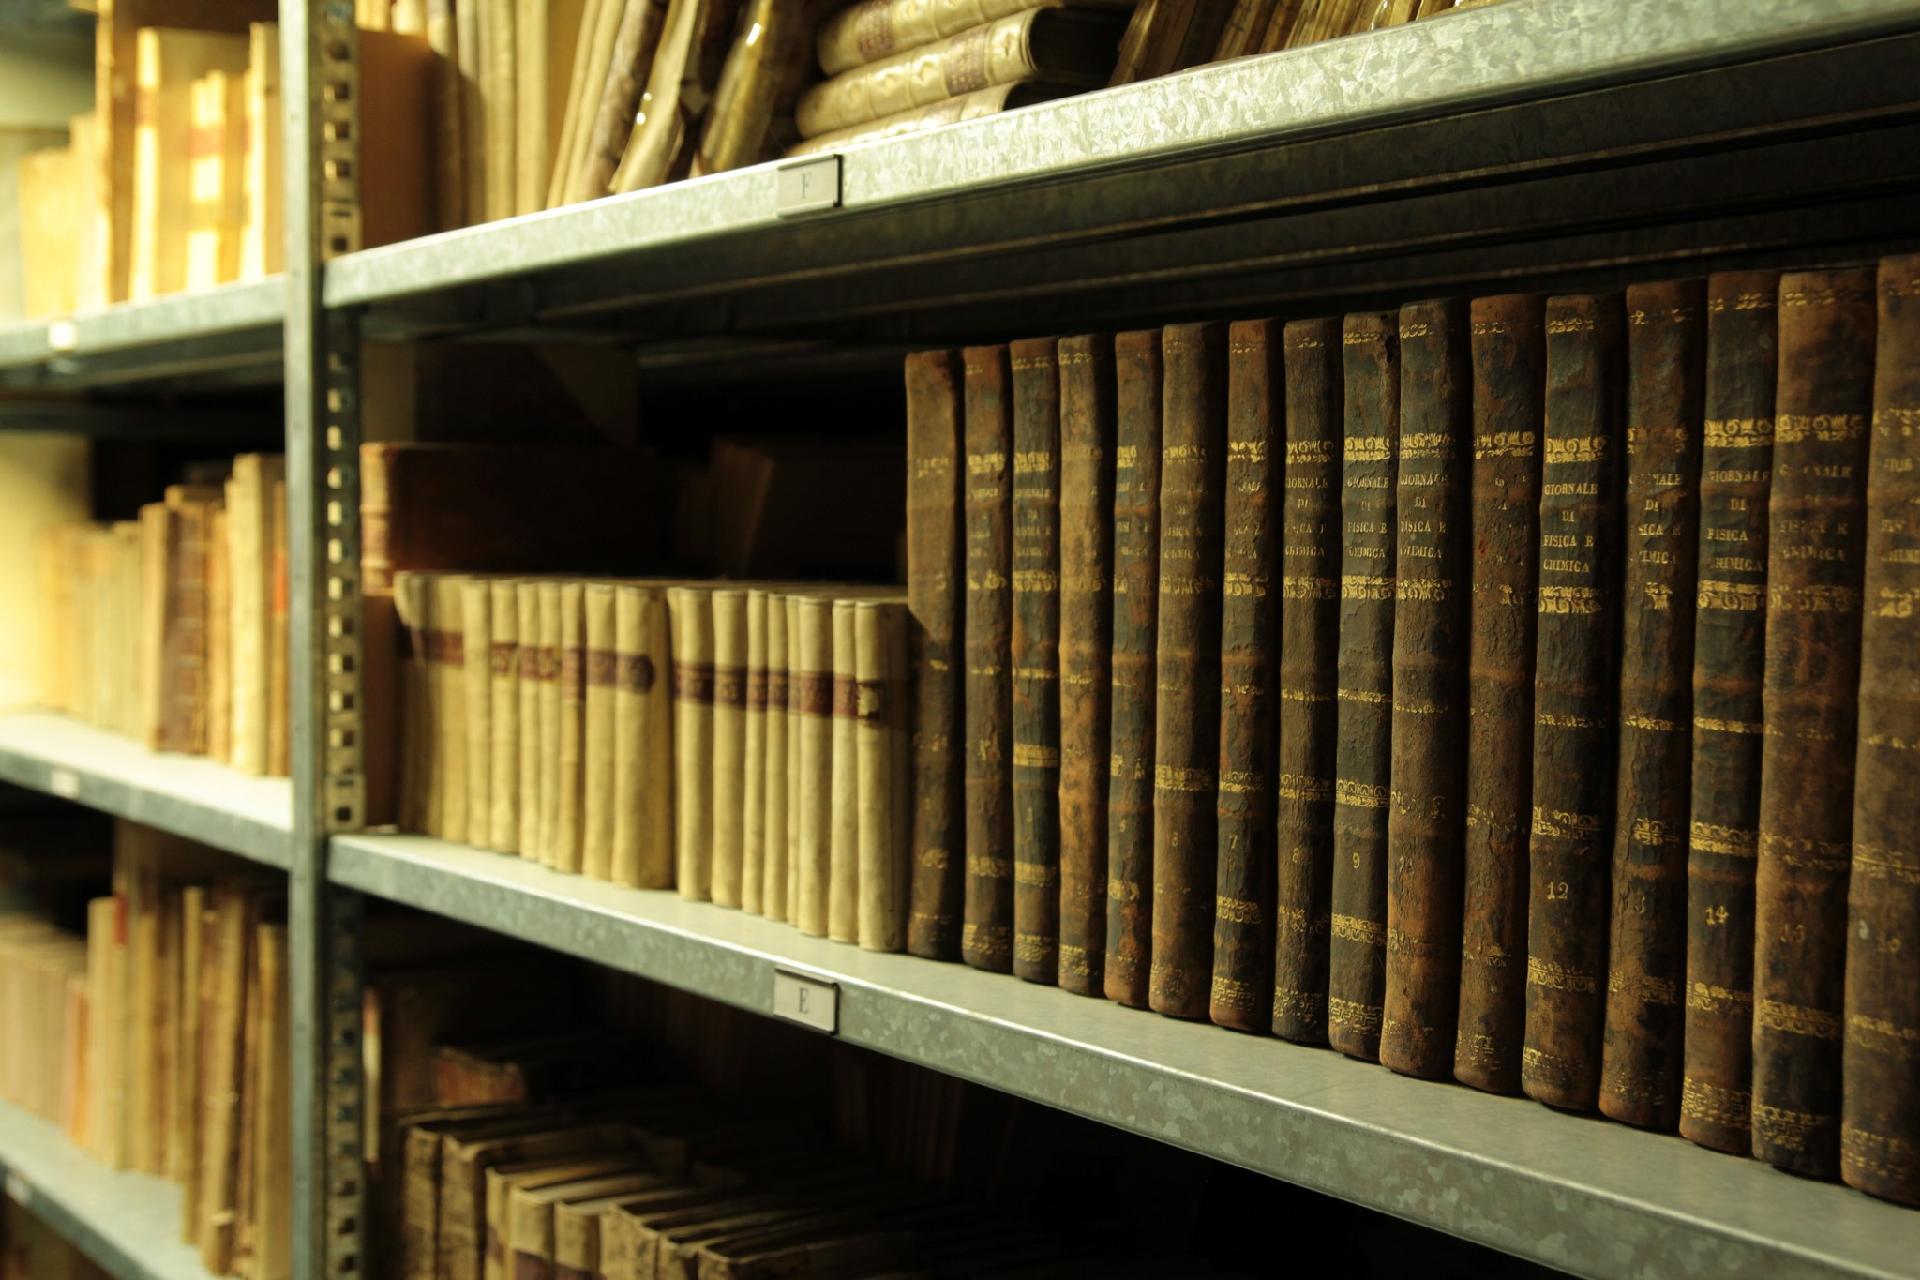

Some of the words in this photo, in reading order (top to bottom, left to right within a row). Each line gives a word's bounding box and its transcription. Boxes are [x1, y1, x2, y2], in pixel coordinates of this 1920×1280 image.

[1544, 482, 1599, 496] GIORNALE
[1543, 534, 1578, 548] FISICA
[1584, 535, 1595, 548] E
[1705, 527, 1749, 541] FISICA
[1543, 559, 1591, 573] CHIMICA
[1352, 851, 1361, 869] 9
[1546, 880, 1569, 900] 12
[1705, 904, 1729, 926] 14
[799, 987, 809, 1014] E
